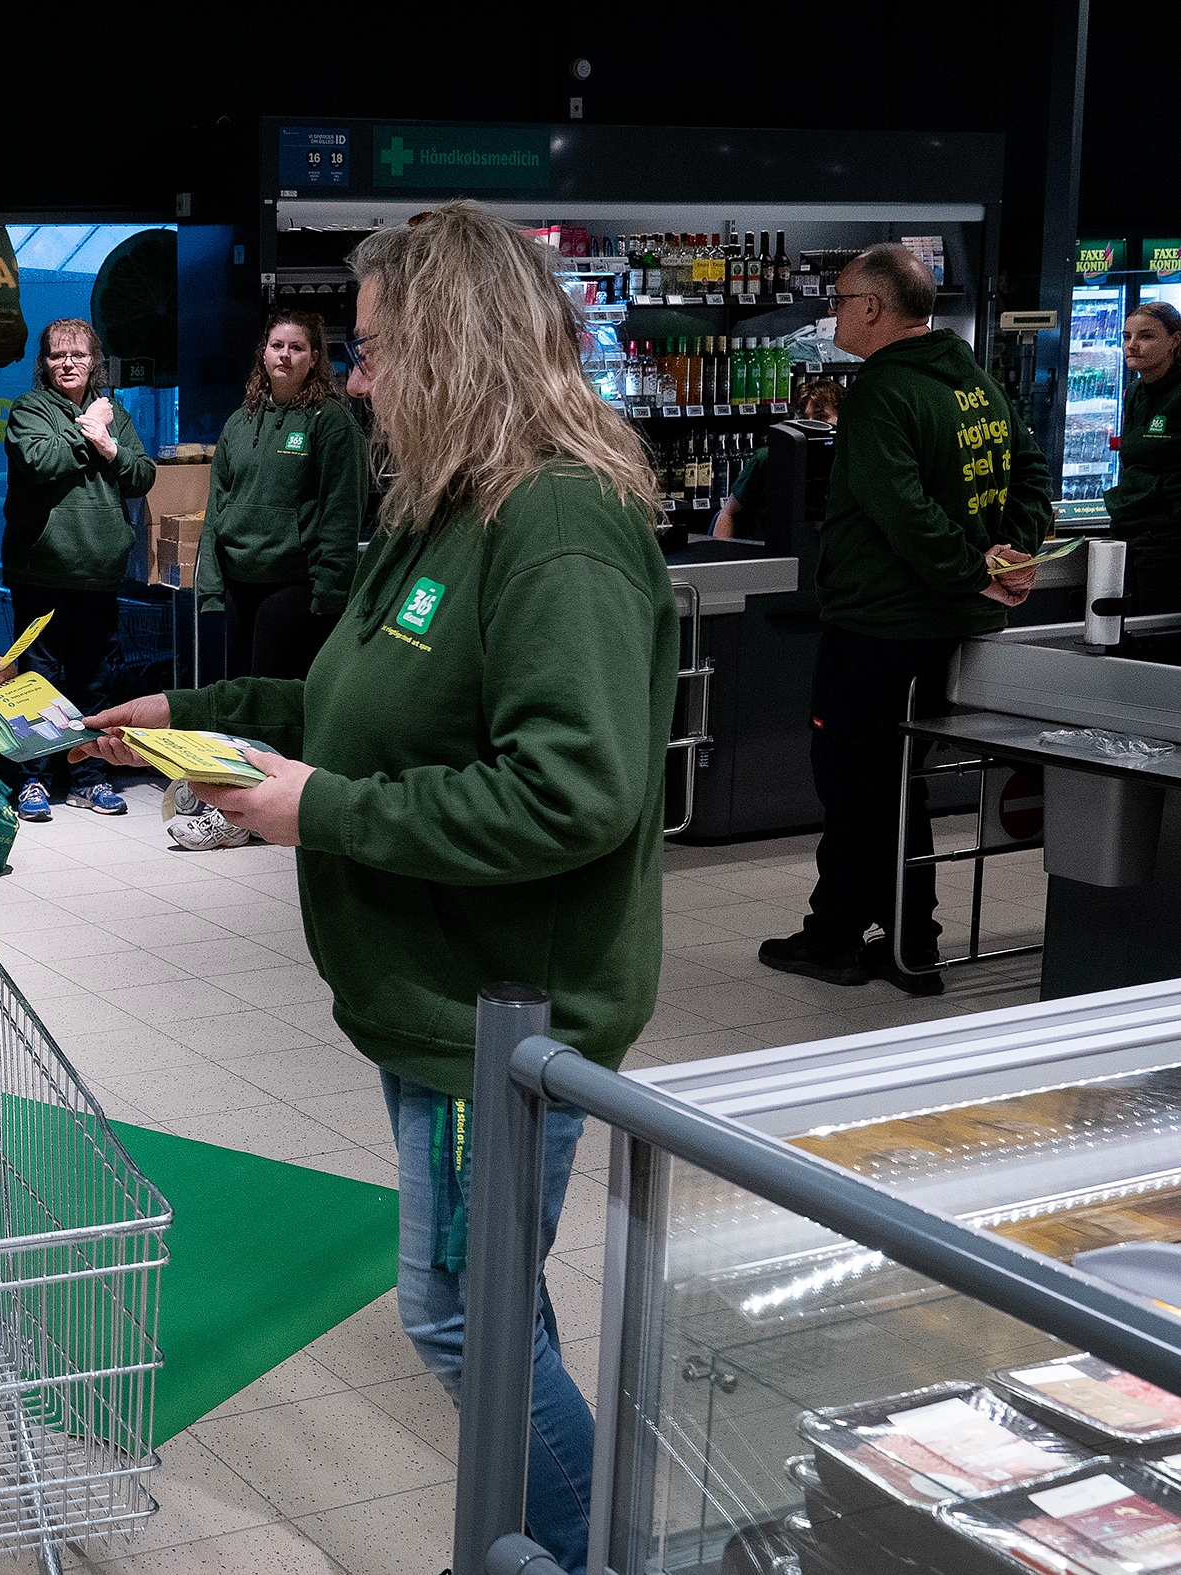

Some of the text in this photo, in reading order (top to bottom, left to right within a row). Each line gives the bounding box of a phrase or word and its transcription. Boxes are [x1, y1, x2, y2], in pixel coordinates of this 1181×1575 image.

[335, 134, 346, 145] ID
[308, 152, 343, 164] 16 18
[420, 148, 540, 167] Håndkøbsmedicin
[1080, 249, 1106, 261] FAXE
[1154, 248, 1179, 260] FAXE
[1076, 261, 1109, 272] KONDI
[954, 387, 989, 411] Det
[288, 436, 303, 445] 365
[407, 589, 437, 616] 365
[456, 1113, 466, 1134] sted
[456, 1133, 465, 1146] at
[455, 1146, 464, 1171] spare
